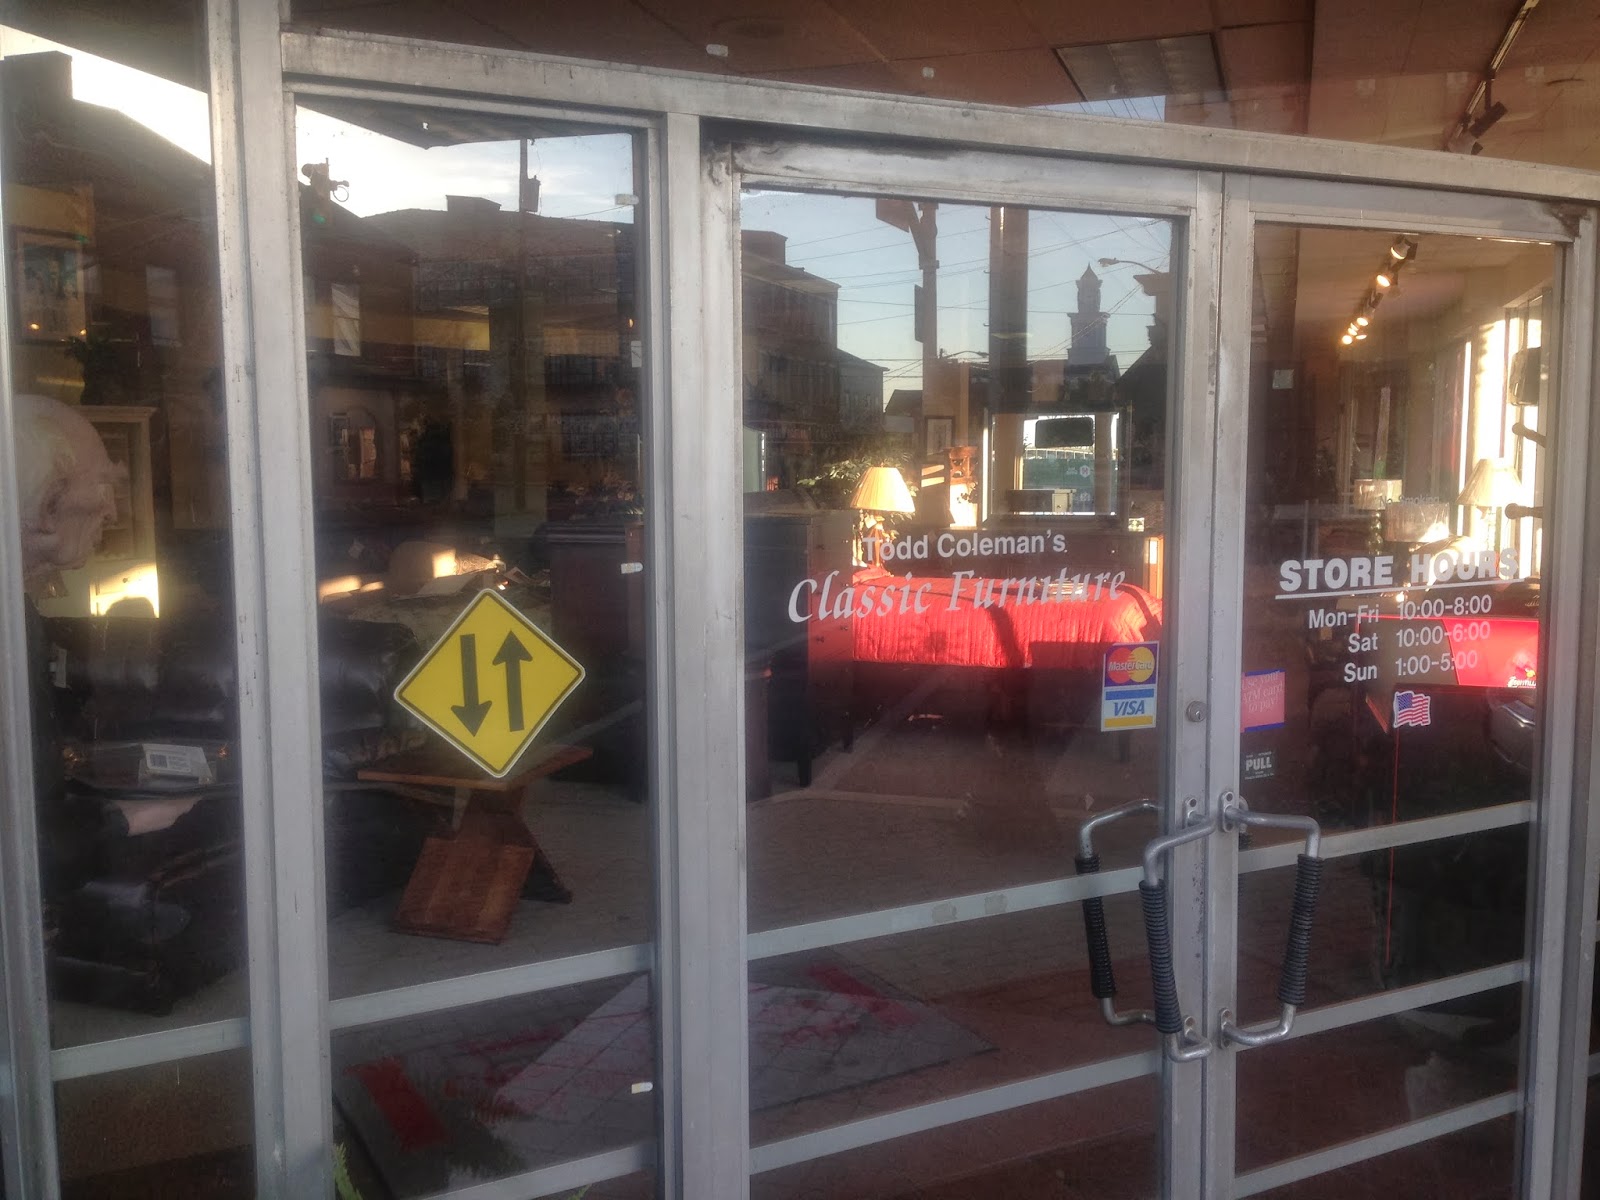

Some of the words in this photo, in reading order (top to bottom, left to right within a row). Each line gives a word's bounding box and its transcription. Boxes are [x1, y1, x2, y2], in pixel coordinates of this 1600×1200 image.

[862, 535, 928, 561] Todd
[937, 529, 1066, 558] Coleman's
[1279, 555, 1394, 592] STORE
[1411, 548, 1518, 584] HOURS
[787, 569, 932, 623] Classic
[945, 565, 1126, 612] Furniture
[1308, 604, 1380, 629] Mon-Fri
[1397, 594, 1492, 620] 10:00-8:00
[1348, 632, 1378, 653] Sat
[1395, 621, 1491, 648] 10:00-6:00
[1108, 660, 1153, 672] MasterCard
[1344, 662, 1378, 683] Sun
[1395, 650, 1478, 676] 1:00-5:00
[1113, 700, 1146, 717] VISA
[1245, 756, 1272, 771] PULL
